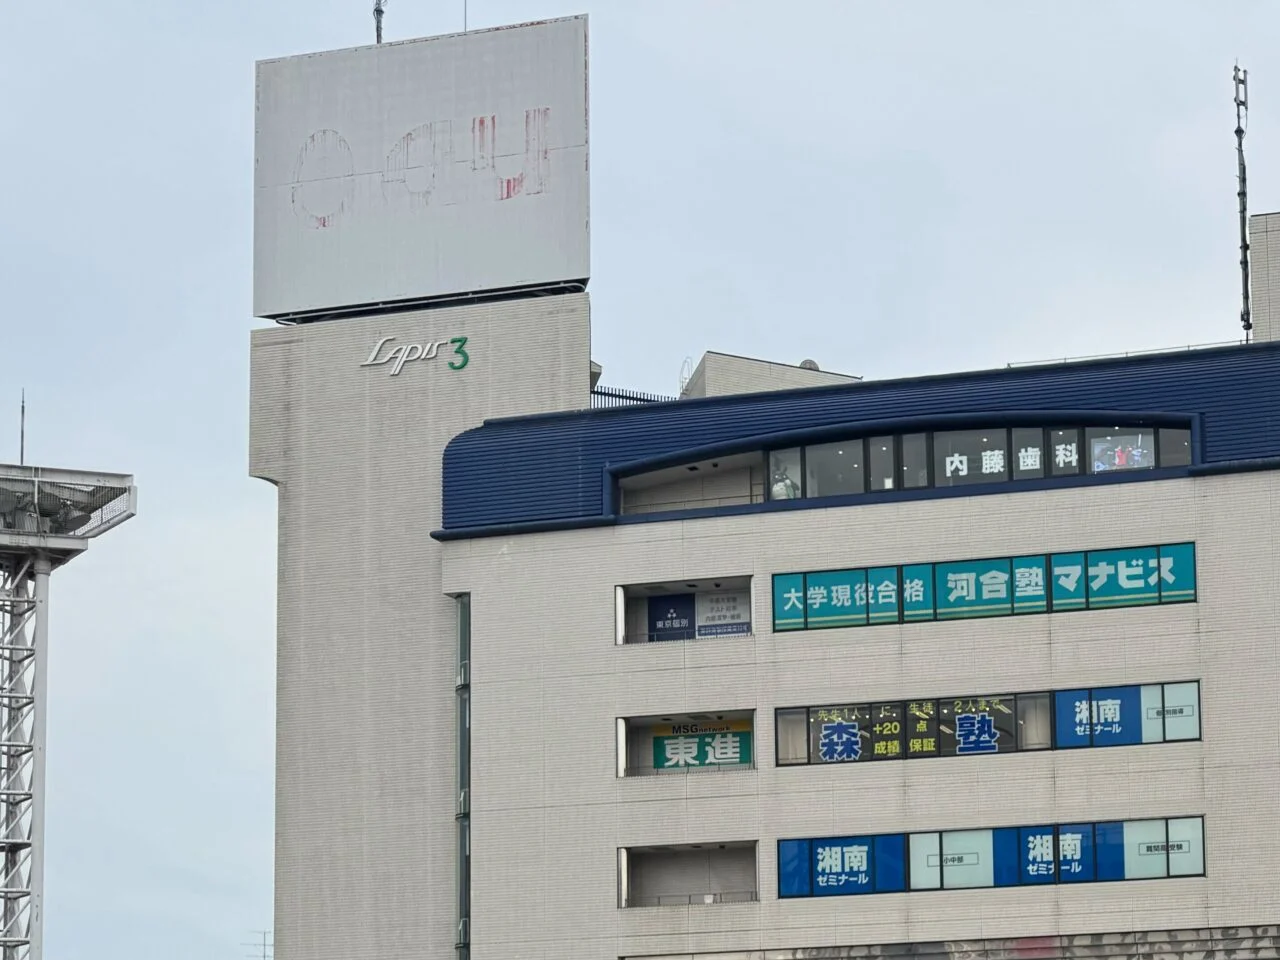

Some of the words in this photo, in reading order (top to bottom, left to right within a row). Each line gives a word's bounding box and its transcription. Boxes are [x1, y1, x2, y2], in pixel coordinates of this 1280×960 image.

[945, 442, 1078, 477] 内藤歯科
[1074, 699, 1122, 725] 湘南
[664, 733, 741, 768] 東進
[816, 845, 869, 873] 湘南
[1027, 832, 1082, 862] 湘南
[816, 873, 869, 886] ゼミナール
